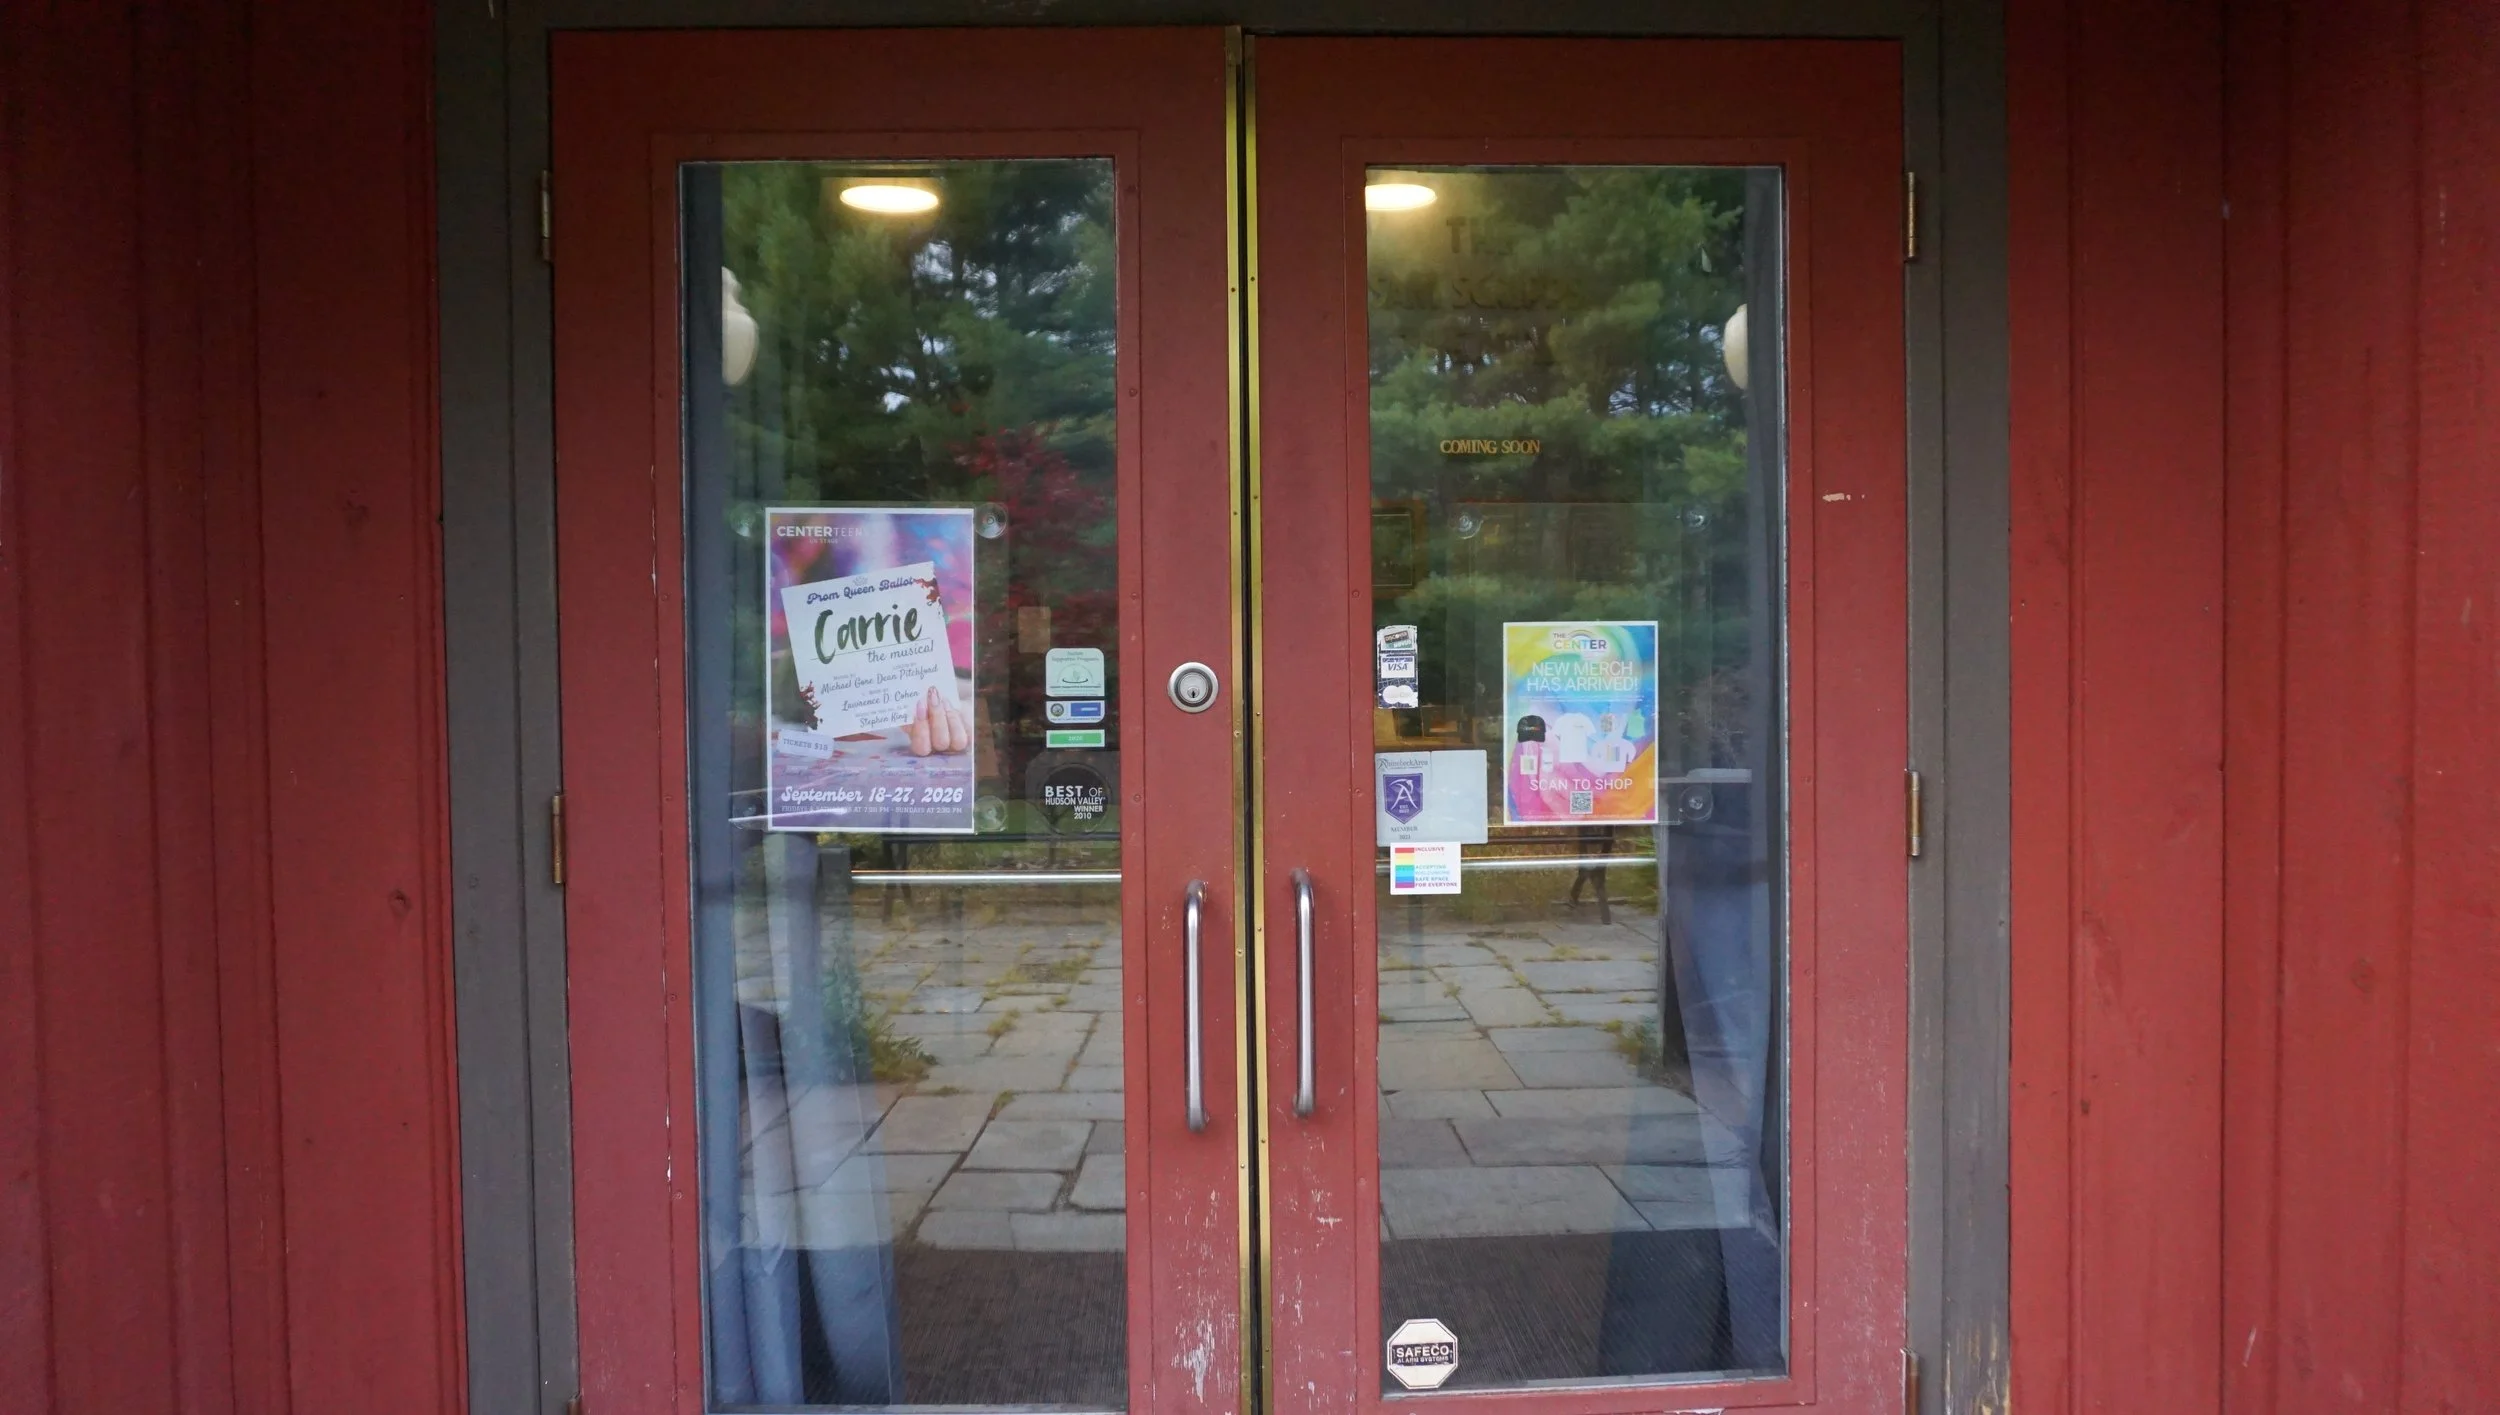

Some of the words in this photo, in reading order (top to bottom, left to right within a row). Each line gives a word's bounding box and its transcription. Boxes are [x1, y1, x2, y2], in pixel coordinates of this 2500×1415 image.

[1440, 440, 1497, 454] COMING
[1501, 440, 1541, 454] SOON
[806, 592, 840, 605] Prom
[843, 584, 876, 599] Queen
[879, 577, 914, 592] Ballot
[814, 603, 923, 664] Carrie
[867, 649, 888, 663] the
[889, 640, 934, 659] musical
[1553, 639, 1607, 650] CENTER
[1387, 663, 1408, 671] VISA
[1532, 661, 1570, 677] NEW
[1574, 660, 1633, 677] MERCH
[820, 680, 852, 695] Michael
[876, 673, 898, 685] Dean
[1527, 677, 1561, 692] HAS
[1565, 676, 1639, 692] ARRIVED!
[894, 690, 920, 702] Cohen
[859, 716, 889, 728] Stephen
[890, 712, 908, 723] King
[1045, 785, 1083, 797] BEST
[1088, 787, 1103, 797] OF
[1529, 779, 1568, 791] SCAN
[1572, 778, 1591, 790] TO
[1595, 778, 1633, 790] SHOP
[781, 785, 864, 804] September
[868, 786, 916, 805] 18-27,
[921, 786, 964, 803] 2026
[1045, 797, 1076, 805] HUDSON
[1074, 805, 1103, 813] WINNER
[1396, 1345, 1449, 1358] SAFECO
